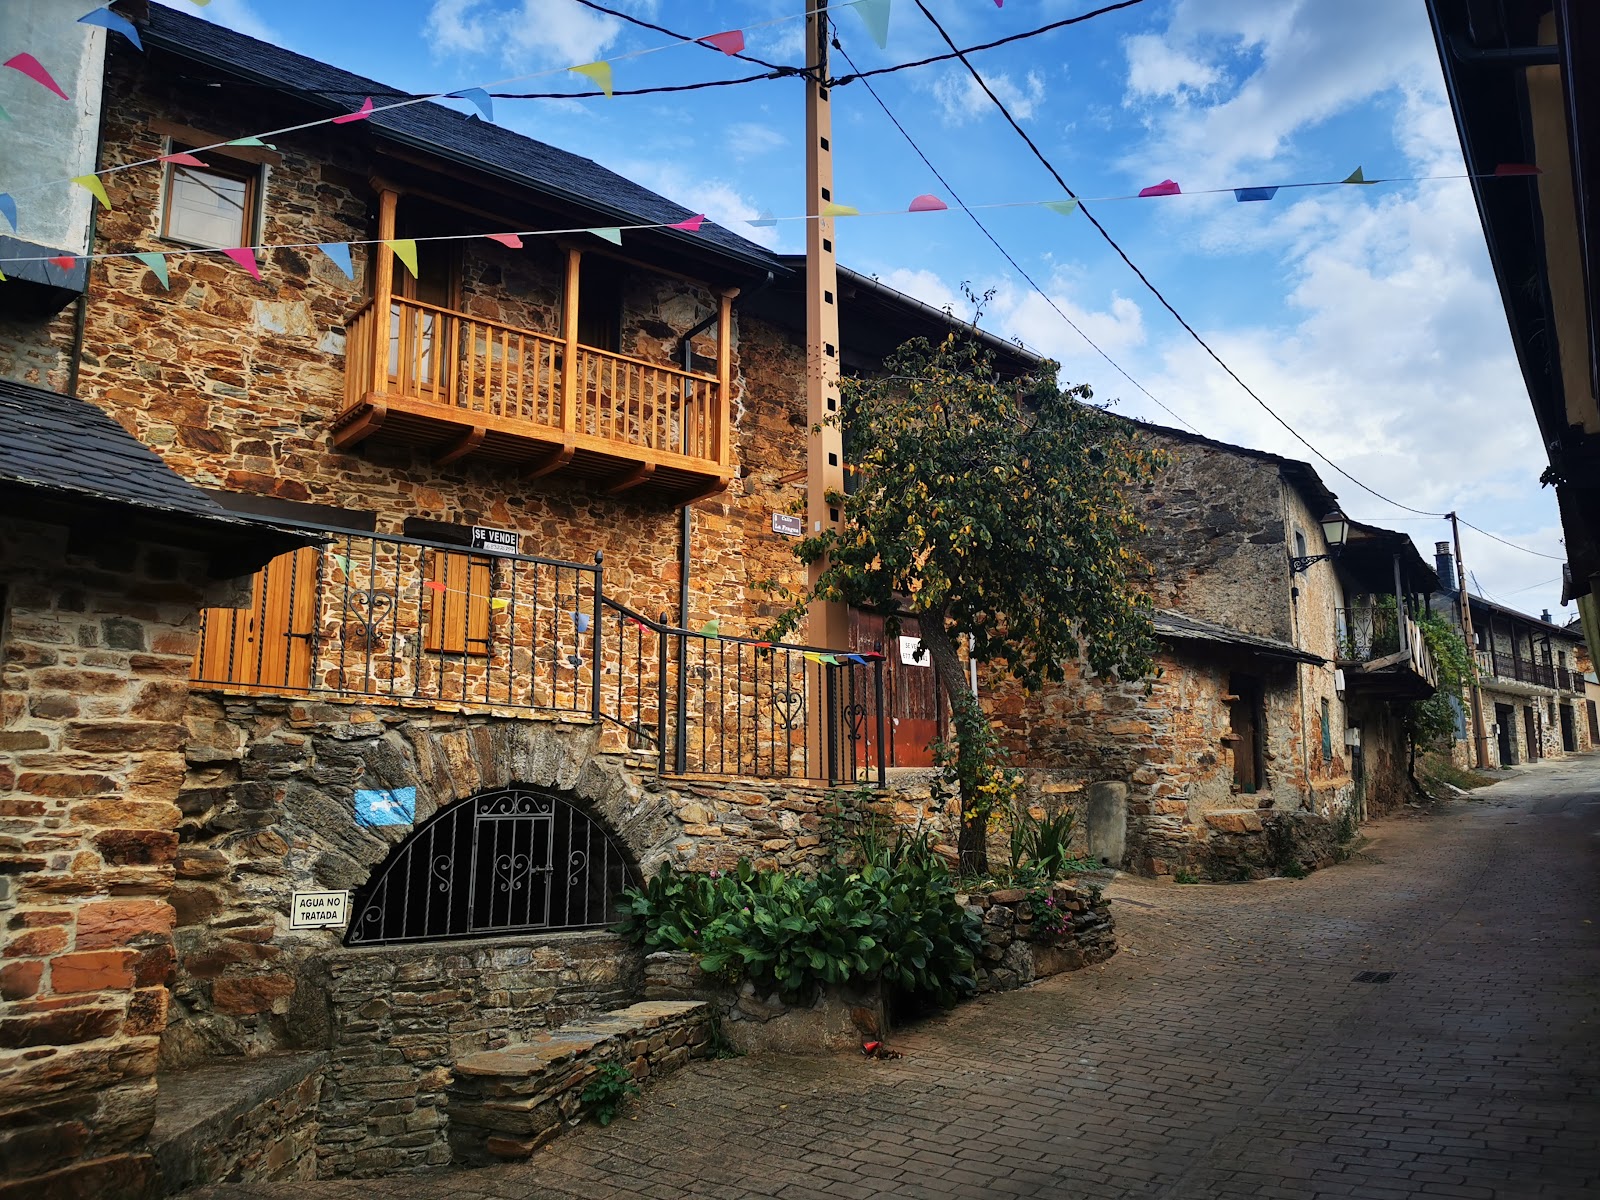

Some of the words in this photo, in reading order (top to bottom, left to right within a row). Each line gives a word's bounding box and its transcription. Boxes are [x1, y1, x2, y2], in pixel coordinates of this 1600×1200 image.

[475, 529, 486, 539] SE
[489, 530, 515, 545] VENDE
[300, 898, 324, 908] AGUA
[327, 897, 340, 907] NO
[301, 911, 337, 920] TRATADA
